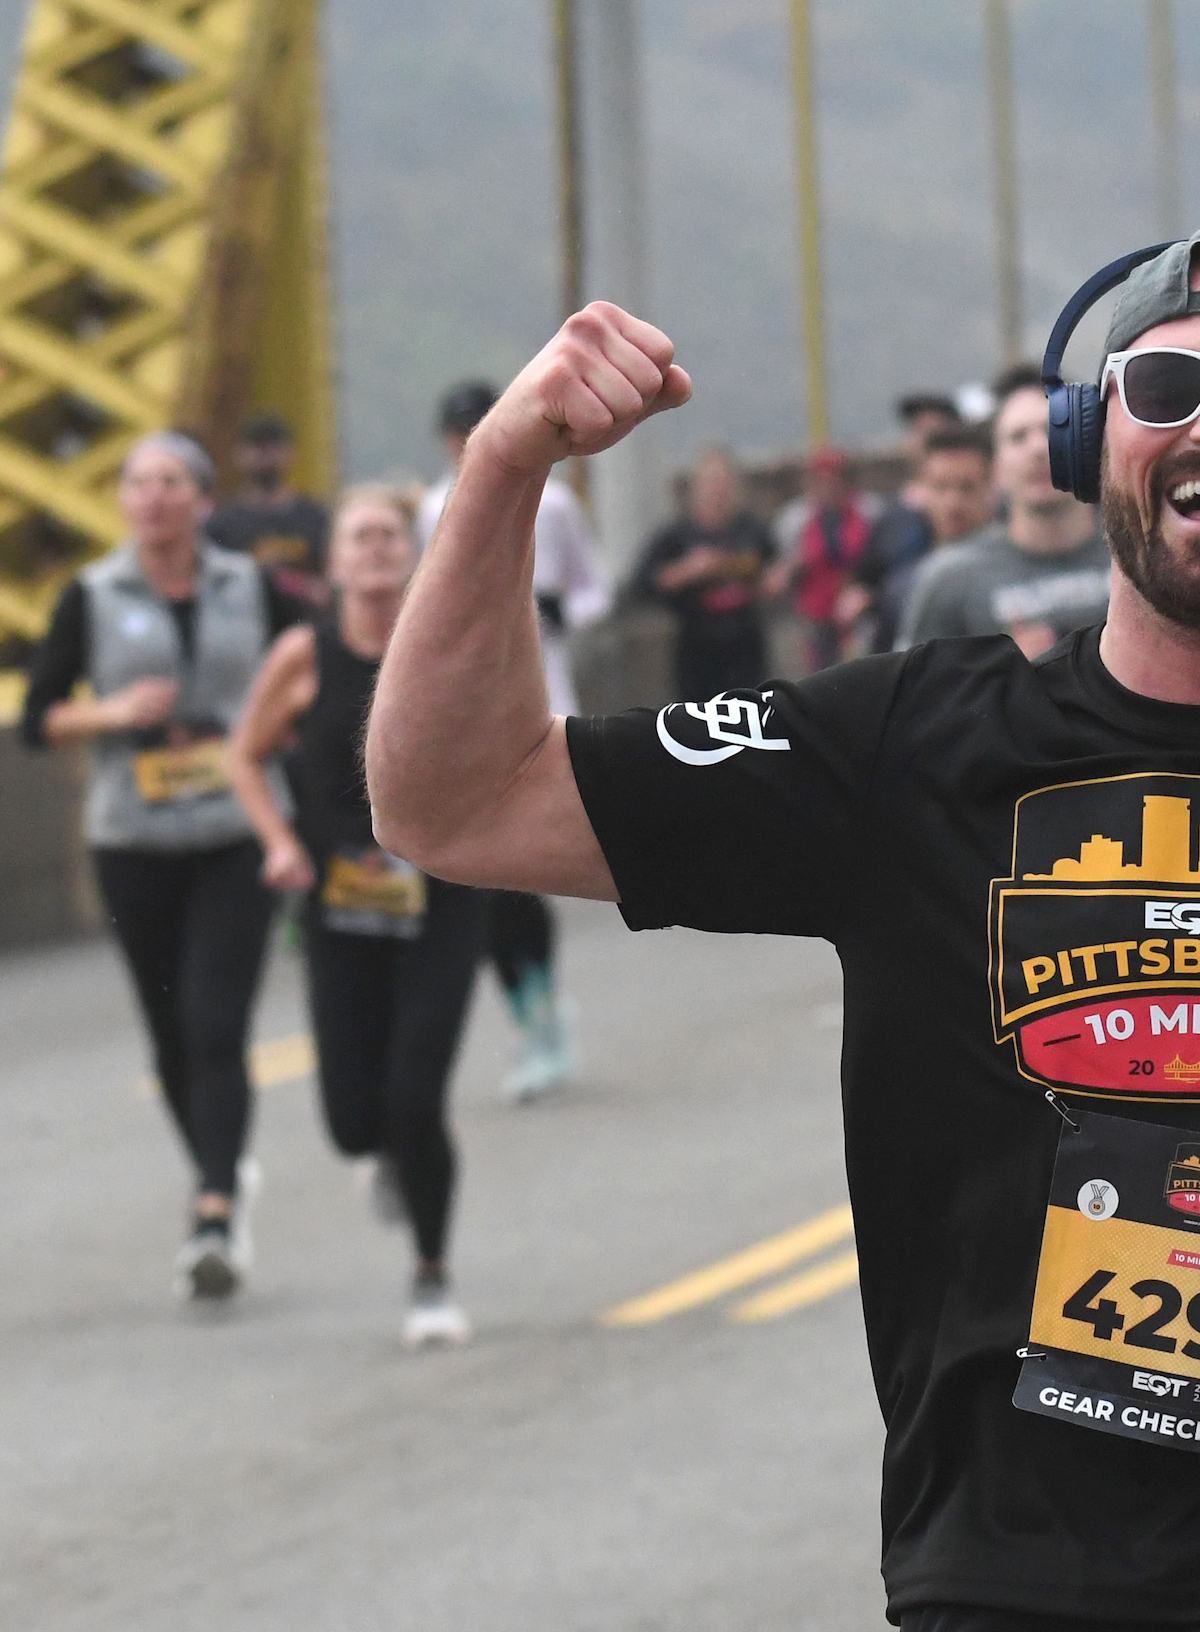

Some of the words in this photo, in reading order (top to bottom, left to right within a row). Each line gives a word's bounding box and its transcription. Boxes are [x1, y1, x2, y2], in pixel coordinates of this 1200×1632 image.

[1084, 1009, 1135, 1045] 10
[1128, 1060, 1155, 1077] 20
[1185, 1194, 1196, 1202] 10
[1175, 1253, 1185, 1262] 10
[1132, 1371, 1190, 1397] EQT
[1039, 1386, 1115, 1421] GEAR
